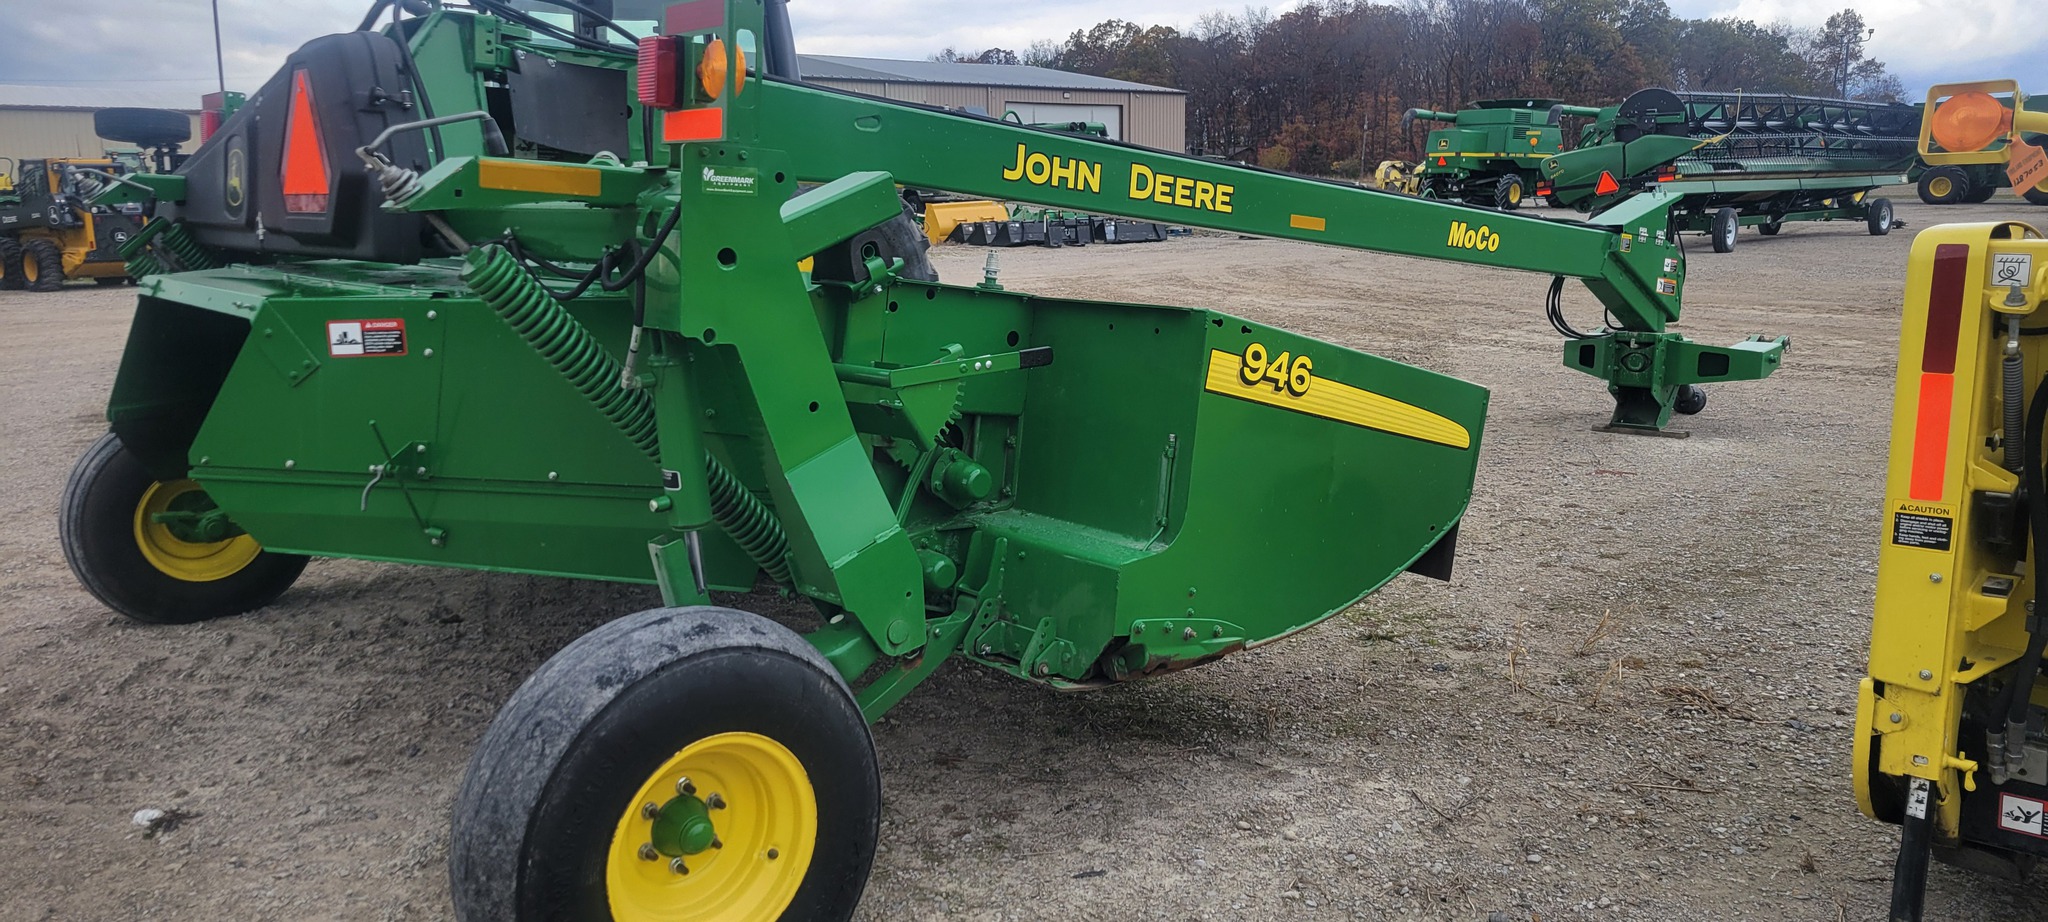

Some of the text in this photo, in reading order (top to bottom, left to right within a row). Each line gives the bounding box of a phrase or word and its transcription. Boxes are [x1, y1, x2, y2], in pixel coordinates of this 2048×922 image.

[710, 175, 754, 184] GREENMARK
[1002, 142, 1234, 213] JOHN DEERE
[1447, 220, 1500, 253] MoCo
[1240, 342, 1313, 398] 946
[1908, 504, 1950, 516] CAUTION
